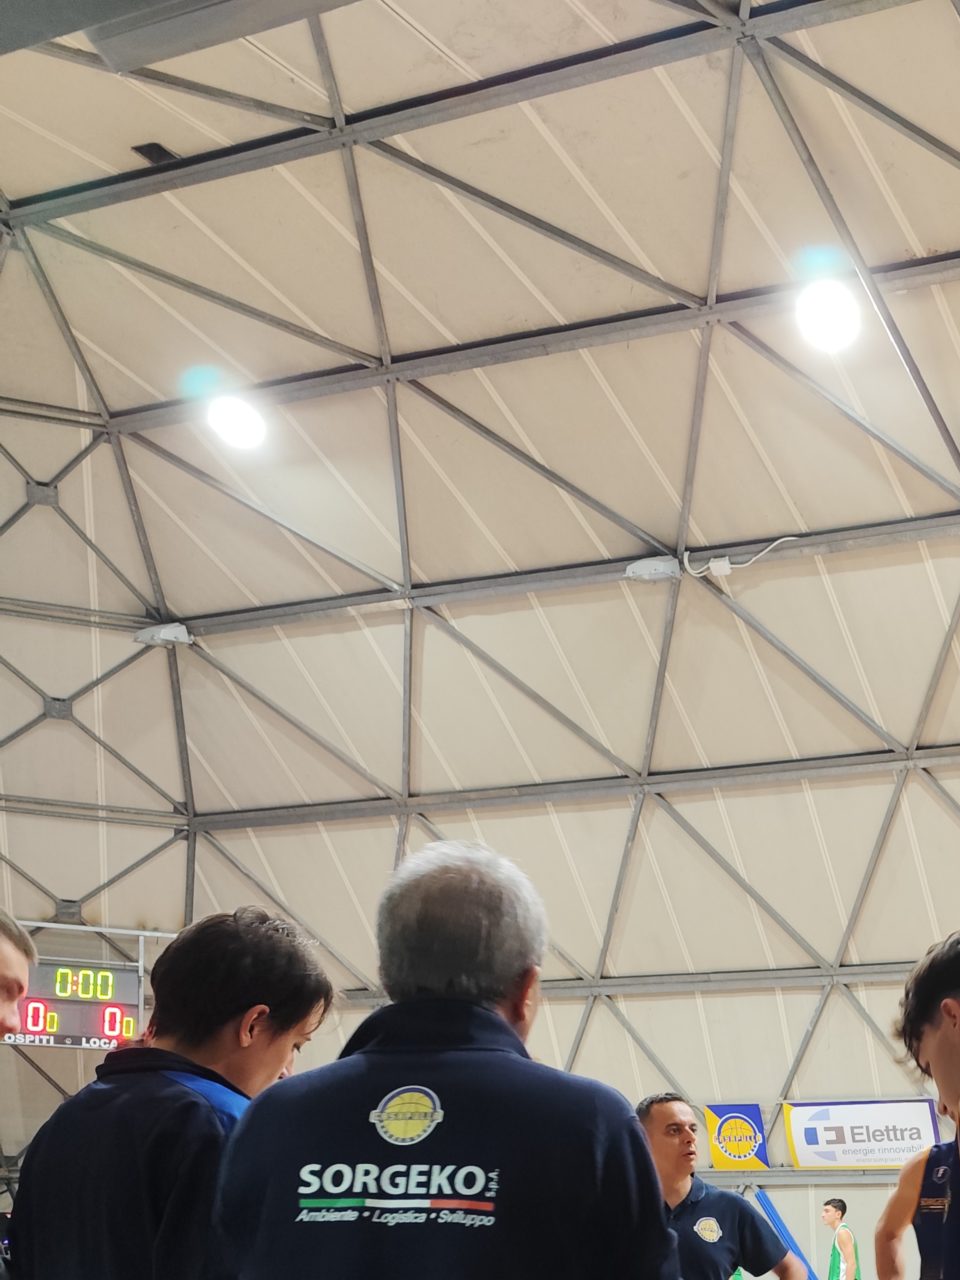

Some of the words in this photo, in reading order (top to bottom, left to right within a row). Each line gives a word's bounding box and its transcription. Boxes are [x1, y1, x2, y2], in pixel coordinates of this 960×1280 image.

[56, 968, 113, 999] 0:00
[3, 1033, 54, 1045] OSPITI
[850, 1125, 922, 1143] Elettra
[842, 1147, 876, 1157] energie
[297, 1164, 487, 1196] SORGEKO
[295, 1208, 359, 1222] Ambiente
[372, 1209, 427, 1227] Logistica
[437, 1209, 495, 1227] Sviluppo
